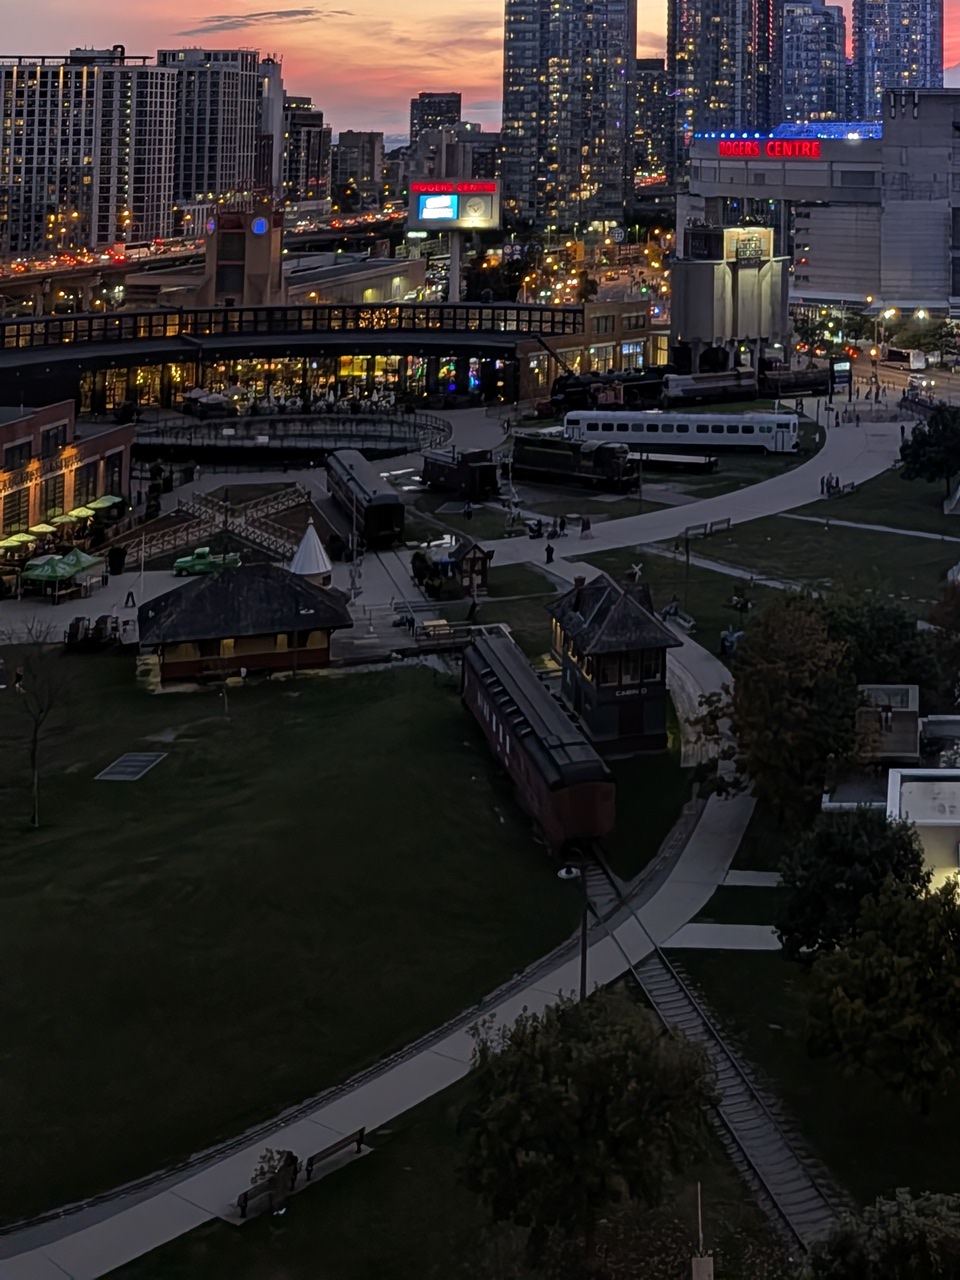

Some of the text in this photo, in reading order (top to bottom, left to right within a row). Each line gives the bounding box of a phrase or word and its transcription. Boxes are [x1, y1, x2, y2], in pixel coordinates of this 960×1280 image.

[720, 141, 819, 157] ROGERS CENTRE
[412, 183, 453, 192] ROGERS
